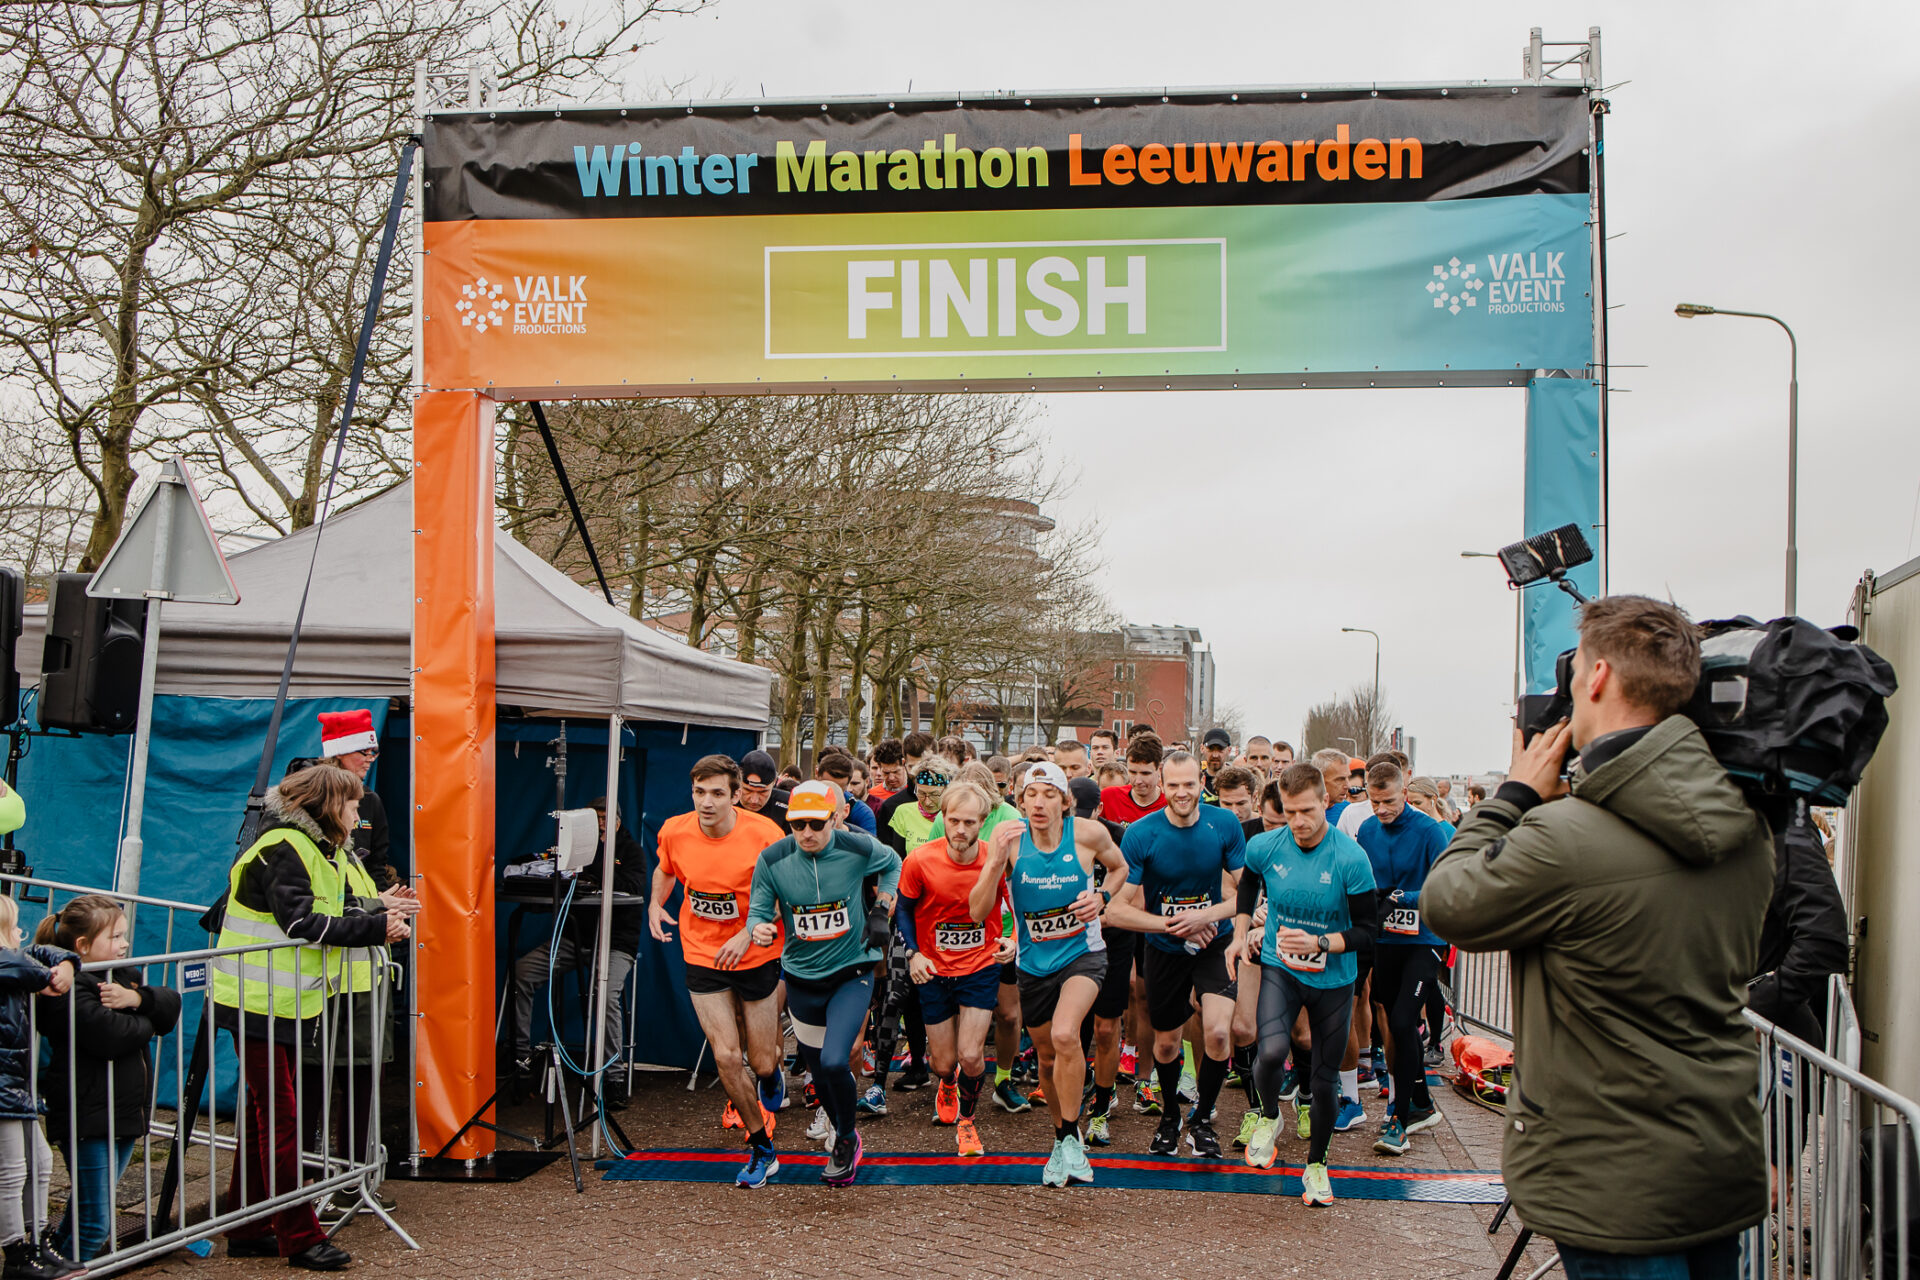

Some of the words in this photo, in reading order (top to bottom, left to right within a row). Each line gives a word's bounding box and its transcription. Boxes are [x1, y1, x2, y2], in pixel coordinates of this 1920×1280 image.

[573, 141, 758, 198] Winter
[775, 133, 1049, 193] Marathon
[1068, 123, 1423, 186] Leeuwarden
[1488, 252, 1565, 280] VALK
[513, 275, 588, 302] VALK
[847, 255, 1147, 339] FINISH
[1488, 280, 1565, 303] EVENT
[514, 302, 588, 324] EVENT
[1488, 302, 1565, 315] PRODUCTIONS
[513, 323, 587, 335] PRODUCTIONS
[692, 899, 735, 916] 2269
[1280, 888, 1326, 907] 42K
[798, 911, 845, 931] 4179
[1031, 913, 1080, 934] 4242
[1386, 911, 1416, 926] 329
[939, 930, 982, 945] 2328
